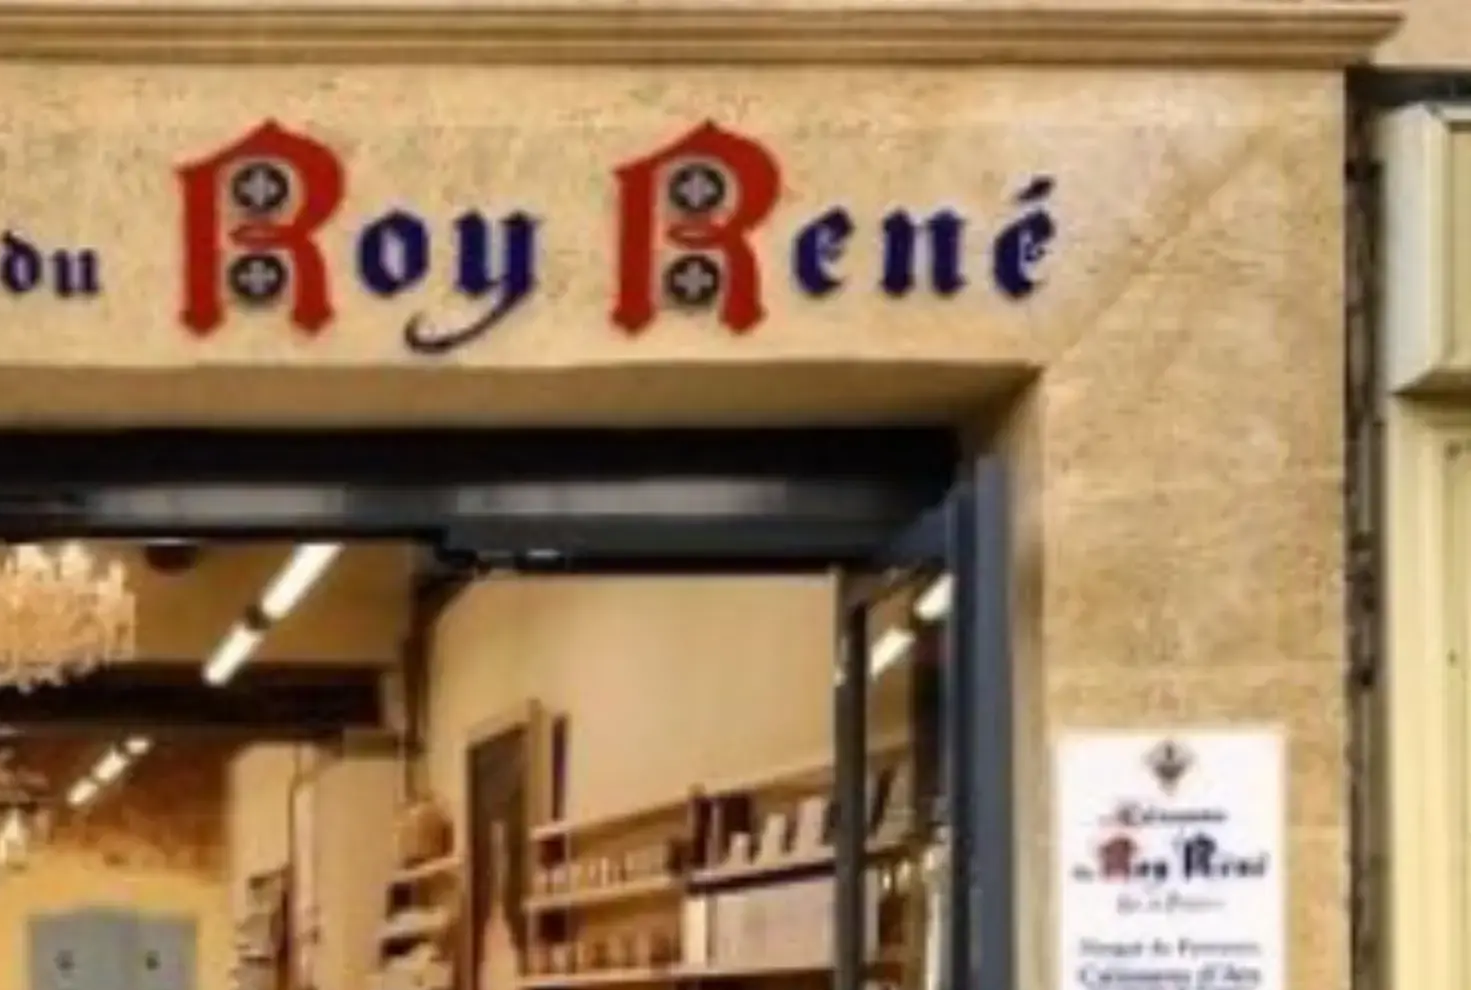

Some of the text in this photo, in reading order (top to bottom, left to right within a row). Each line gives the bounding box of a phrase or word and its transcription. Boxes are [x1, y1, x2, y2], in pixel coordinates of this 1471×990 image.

[0, 230, 100, 299] du
[175, 119, 538, 355] Roy
[609, 121, 1057, 333] René
